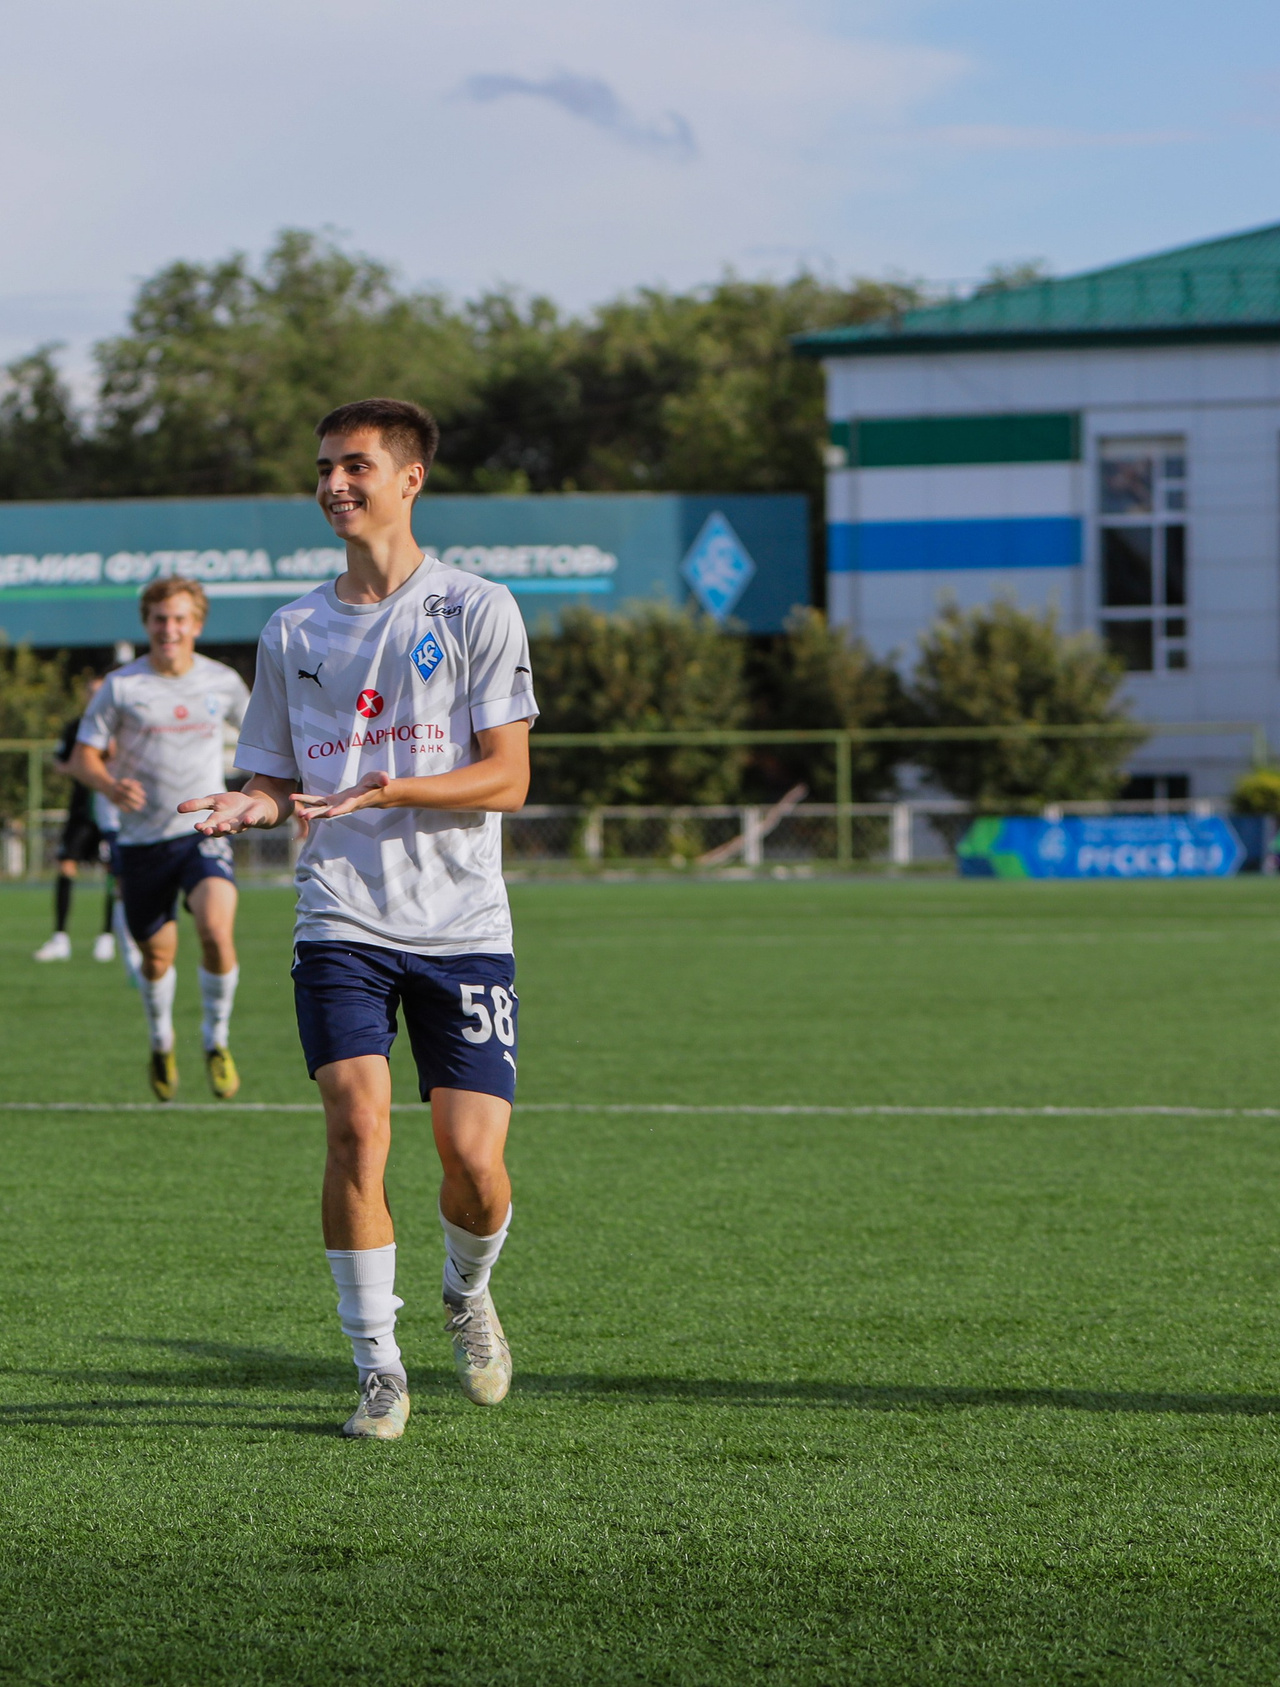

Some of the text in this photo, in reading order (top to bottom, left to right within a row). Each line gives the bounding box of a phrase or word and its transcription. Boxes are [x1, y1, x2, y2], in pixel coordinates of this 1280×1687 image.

[104, 549, 272, 582] ФУТБОЛА
[410, 744, 445, 754] БАНК
[459, 983, 515, 1047] 58
